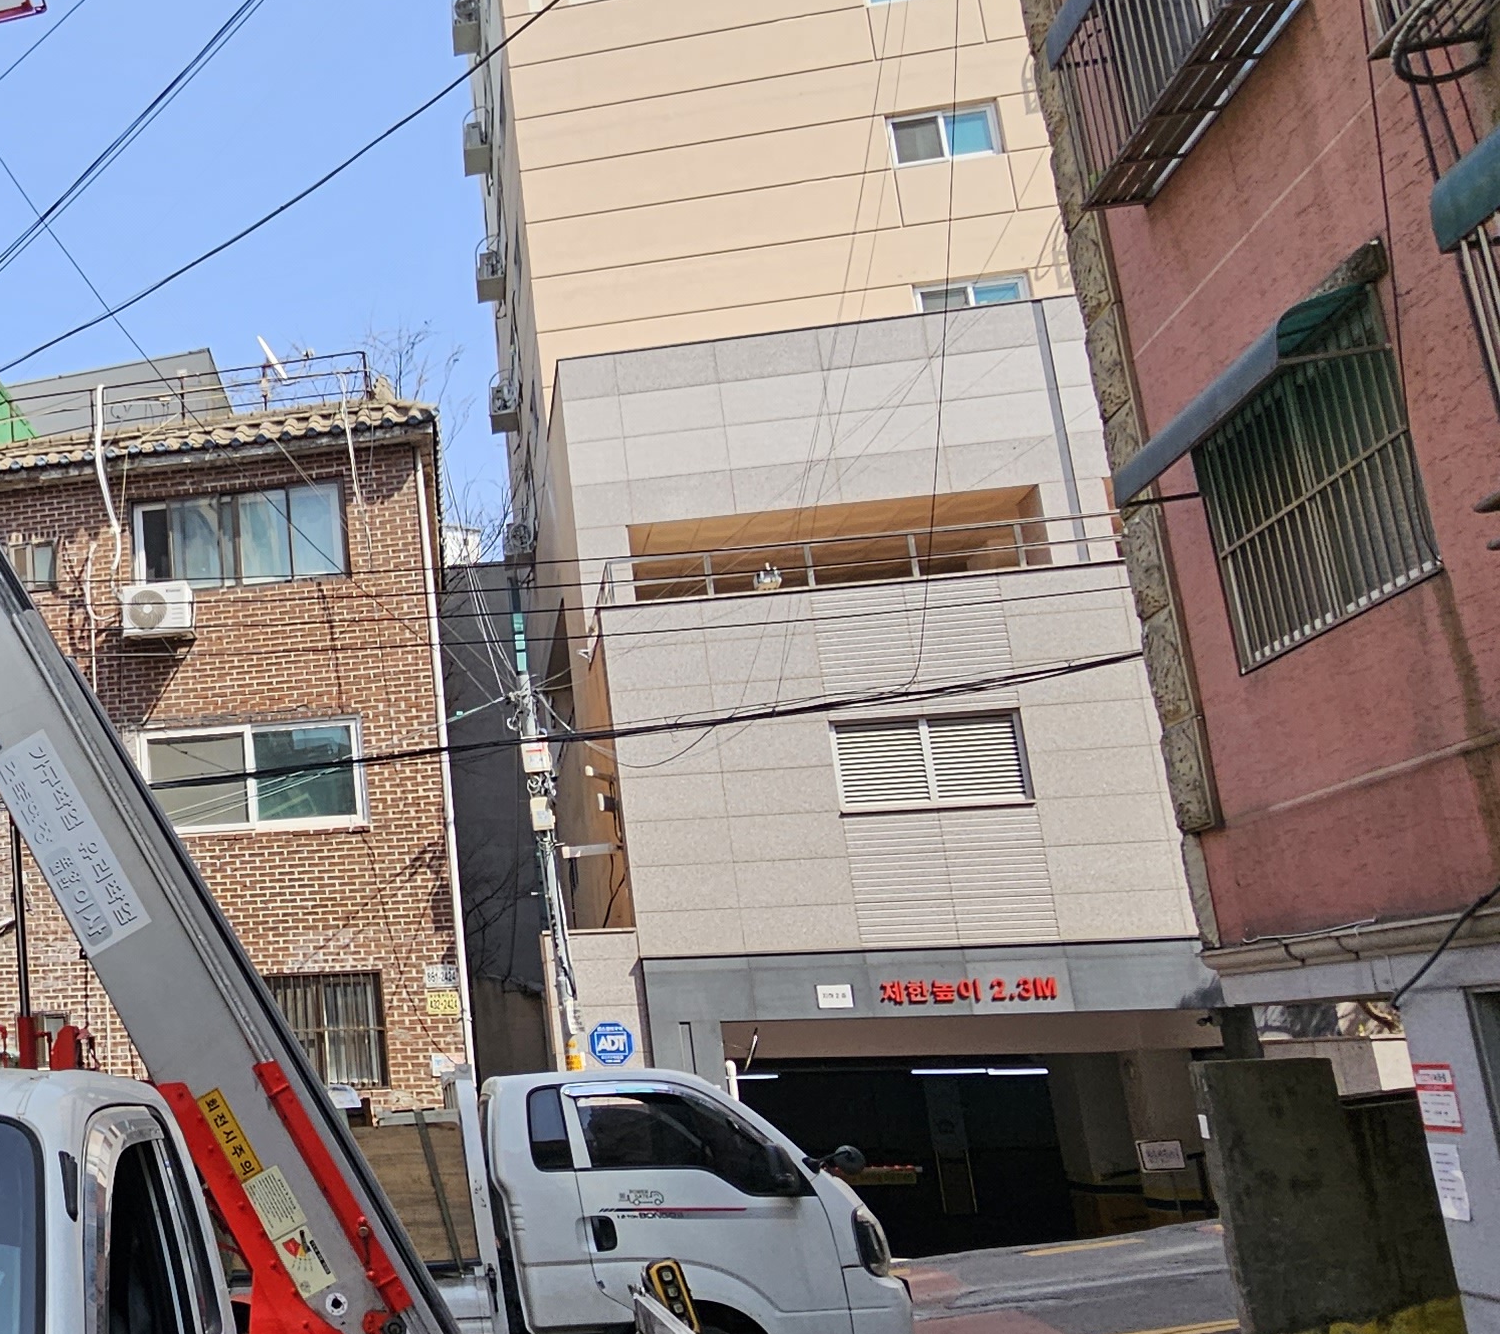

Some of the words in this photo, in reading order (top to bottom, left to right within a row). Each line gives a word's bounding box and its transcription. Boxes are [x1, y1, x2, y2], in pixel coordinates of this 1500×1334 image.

[27, 745, 85, 832] 가구작업
[76, 839, 138, 927] 유리작업
[879, 977, 982, 1004] 제한높이
[989, 976, 1059, 1001] 2.3M
[597, 1034, 626, 1052] ADT
